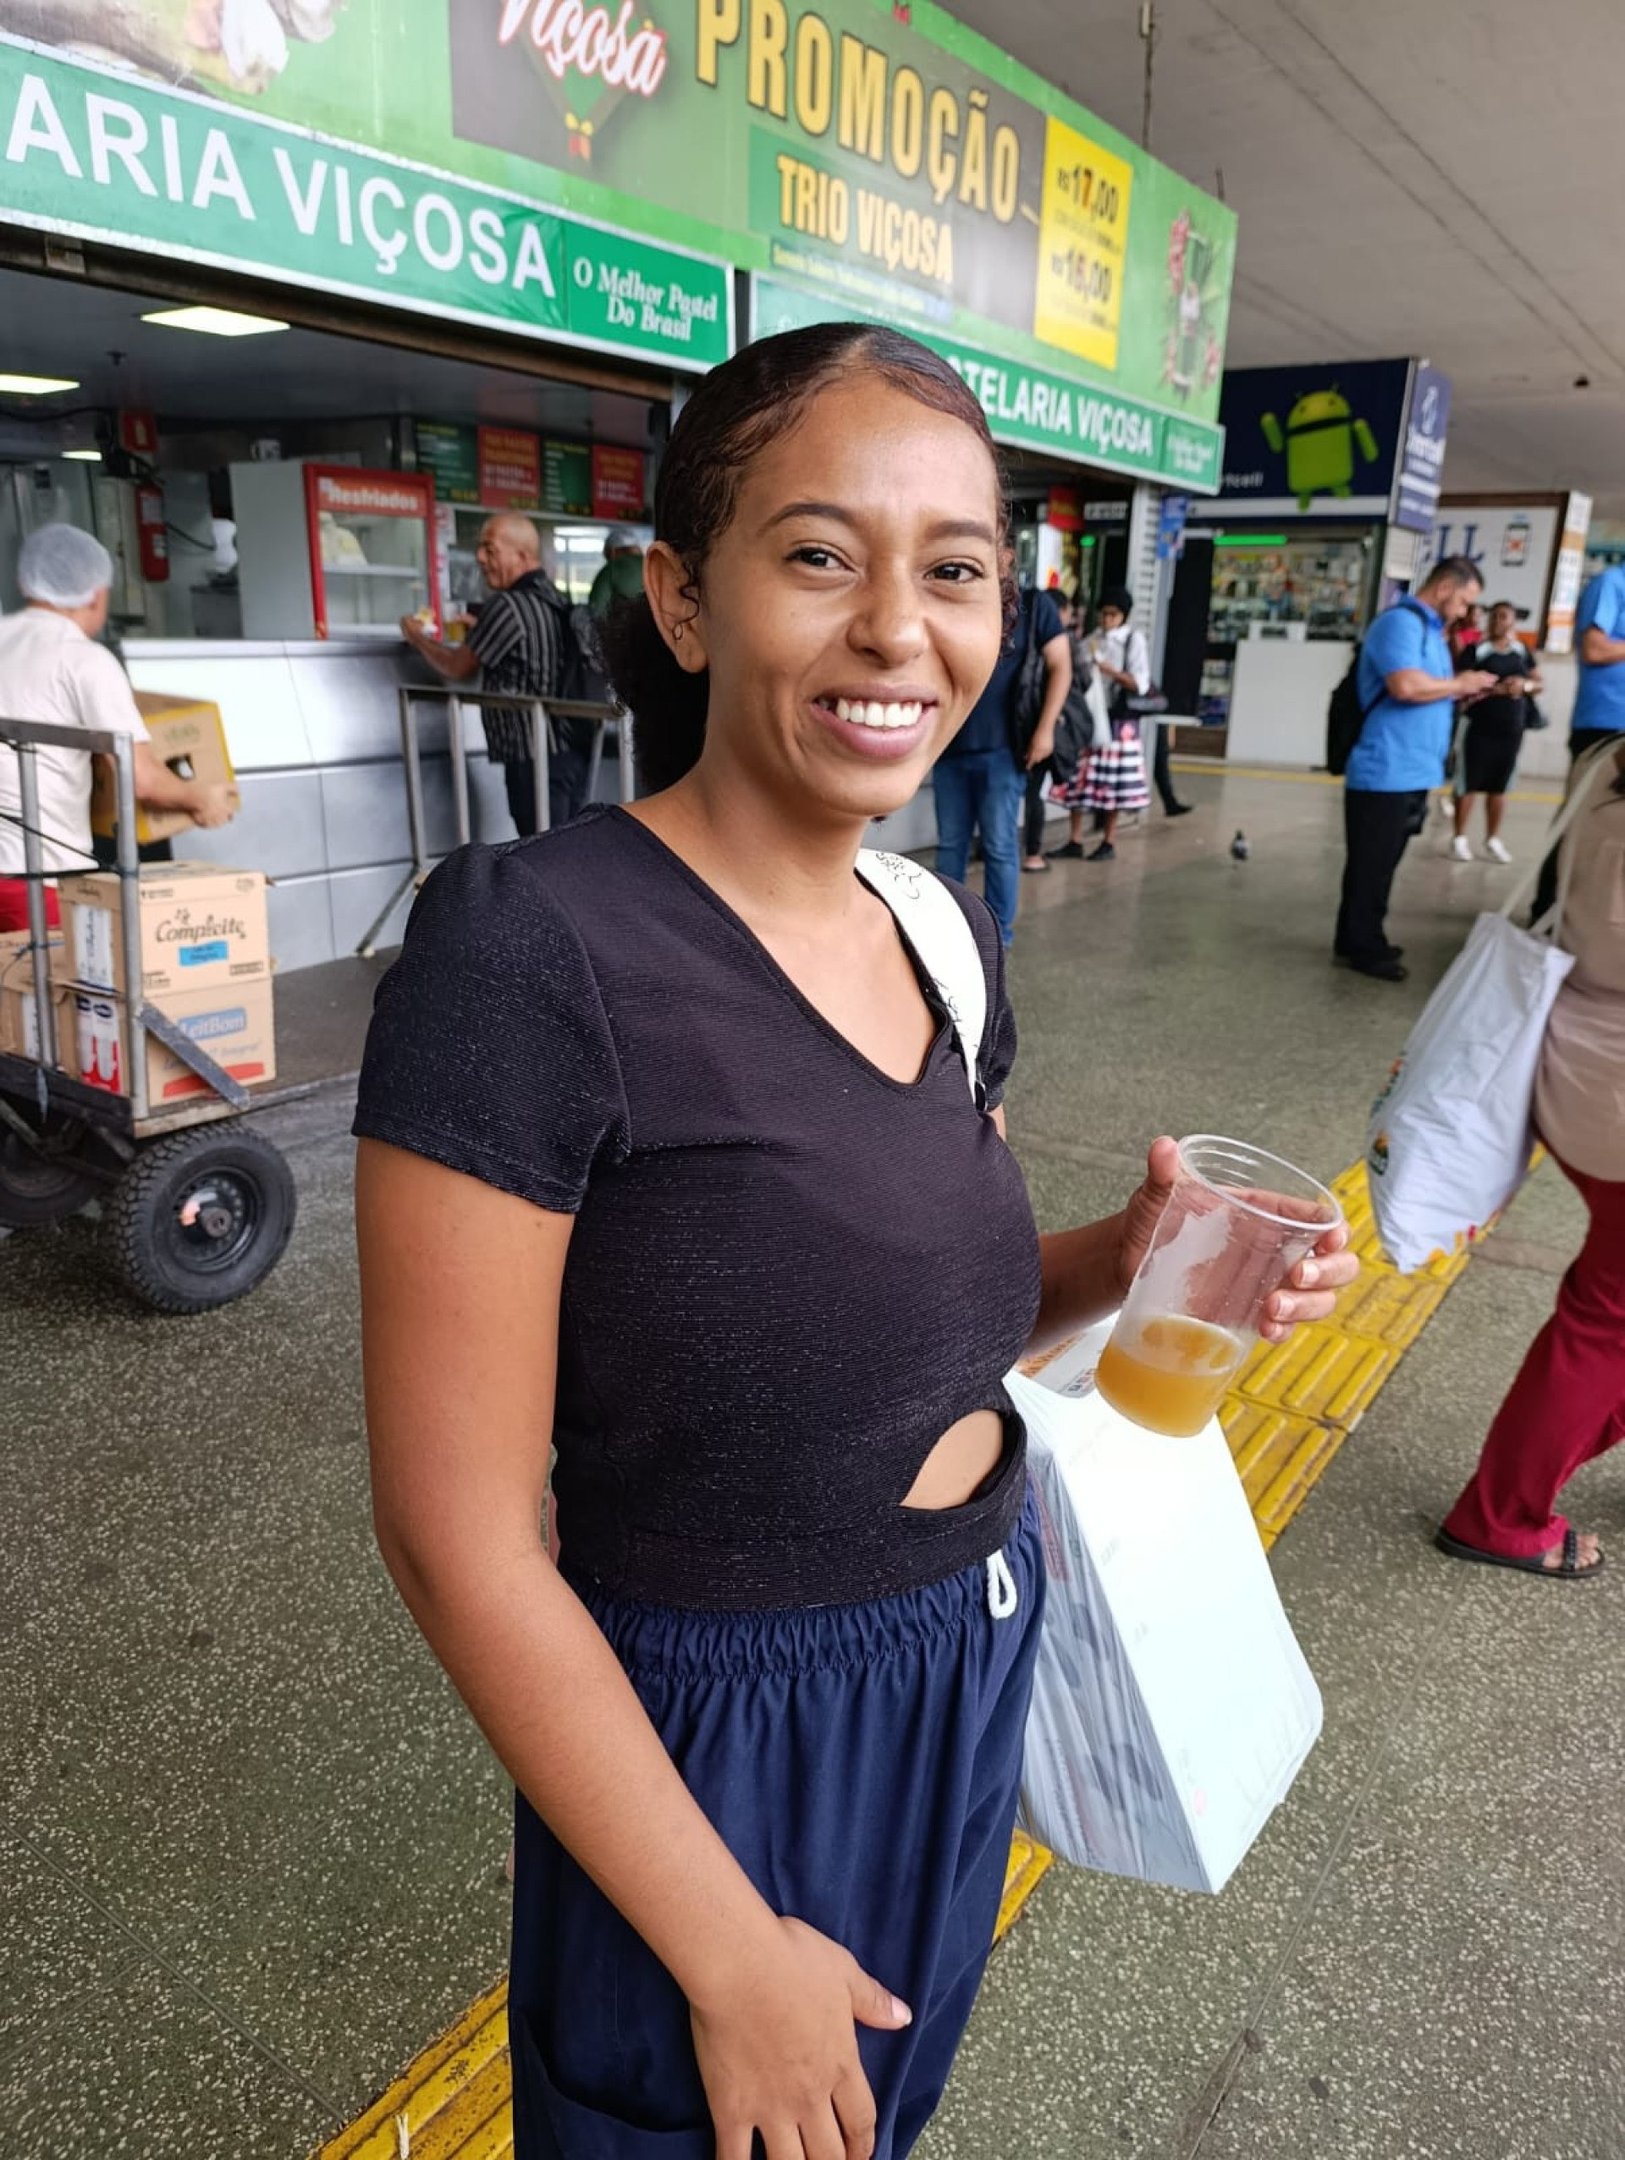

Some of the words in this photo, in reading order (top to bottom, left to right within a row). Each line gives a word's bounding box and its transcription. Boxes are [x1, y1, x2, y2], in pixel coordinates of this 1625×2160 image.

[695, 0, 1022, 225] PROMOÇÃO
[5, 73, 257, 222] ARIA
[272, 146, 556, 299] VIÇOSA
[776, 153, 850, 246] TRIO
[856, 187, 954, 285] VIÇOSA
[573, 257, 594, 288] O
[597, 262, 665, 307] Melhor
[606, 294, 636, 328] Do
[640, 302, 693, 342] Brasil
[1077, 394, 1154, 458] VIÇOSA
